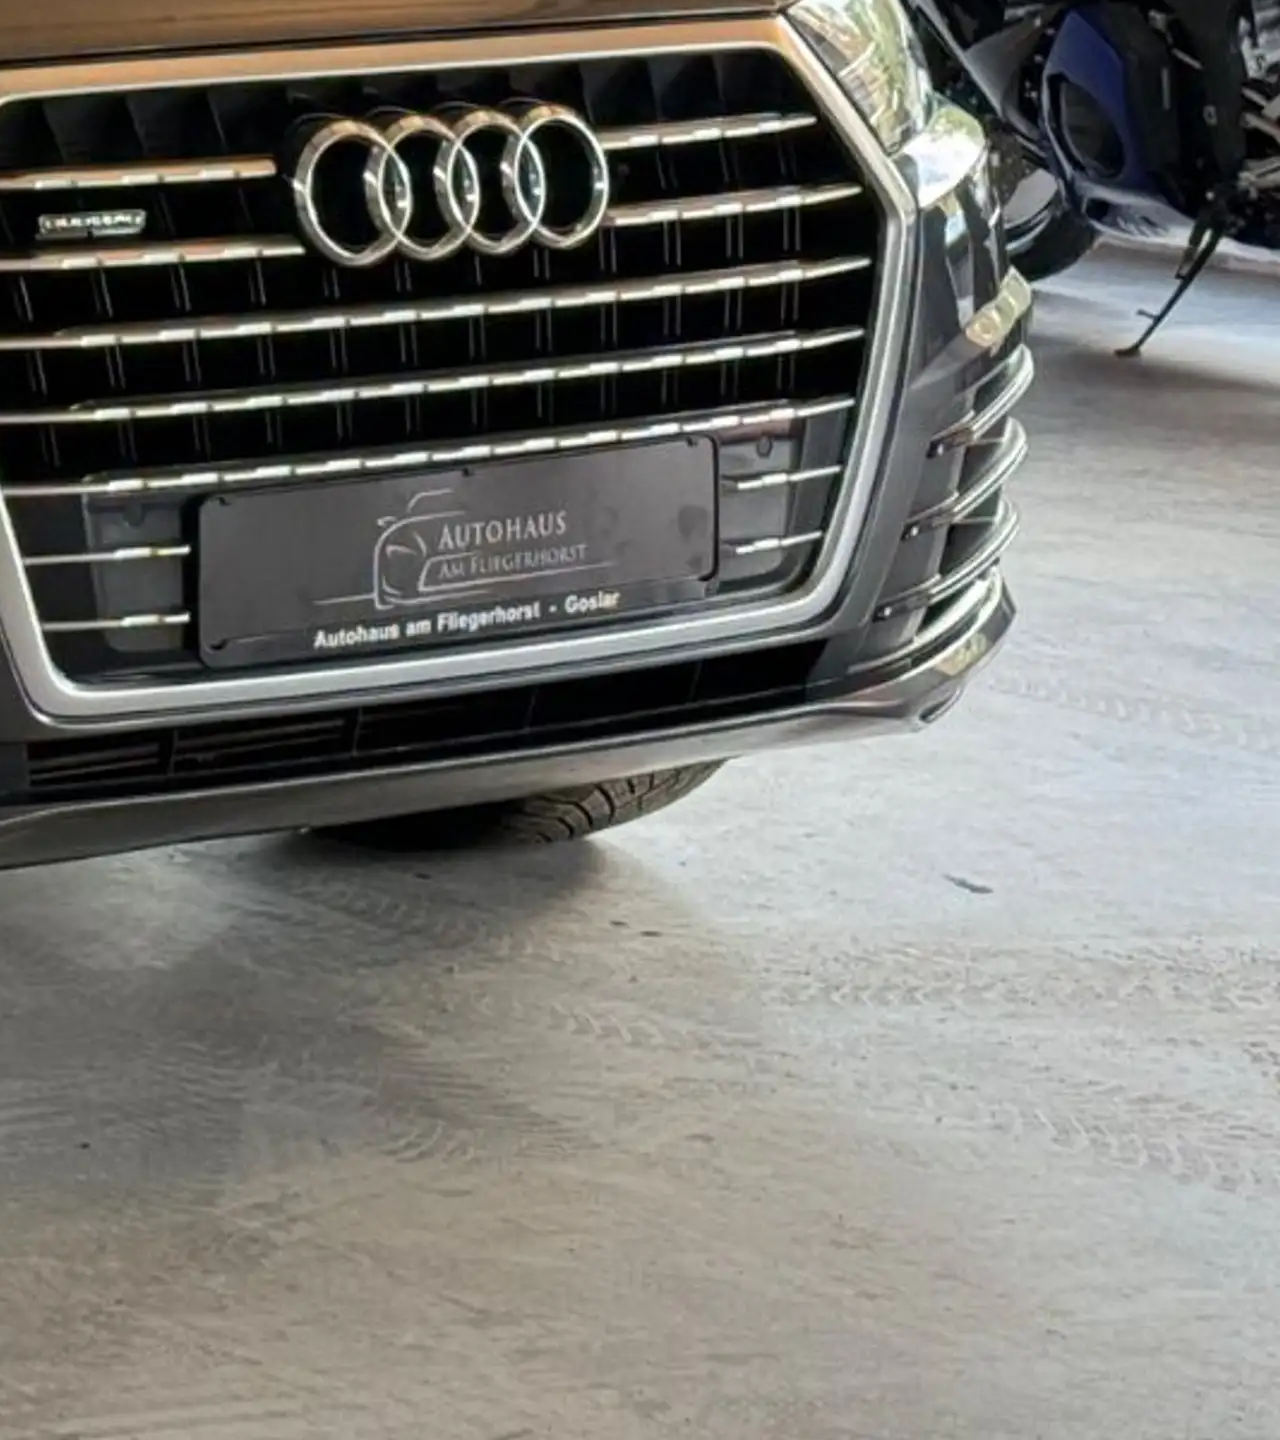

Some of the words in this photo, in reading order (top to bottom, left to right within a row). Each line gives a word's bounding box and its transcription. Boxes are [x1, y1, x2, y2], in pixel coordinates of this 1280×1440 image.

[437, 510, 568, 550] AUTOHAUS
[437, 561, 465, 580] AM
[313, 625, 401, 649] Autohaus
[405, 620, 432, 637] am
[437, 600, 542, 632] Fliegerhorst
[563, 589, 622, 615] Goslar
